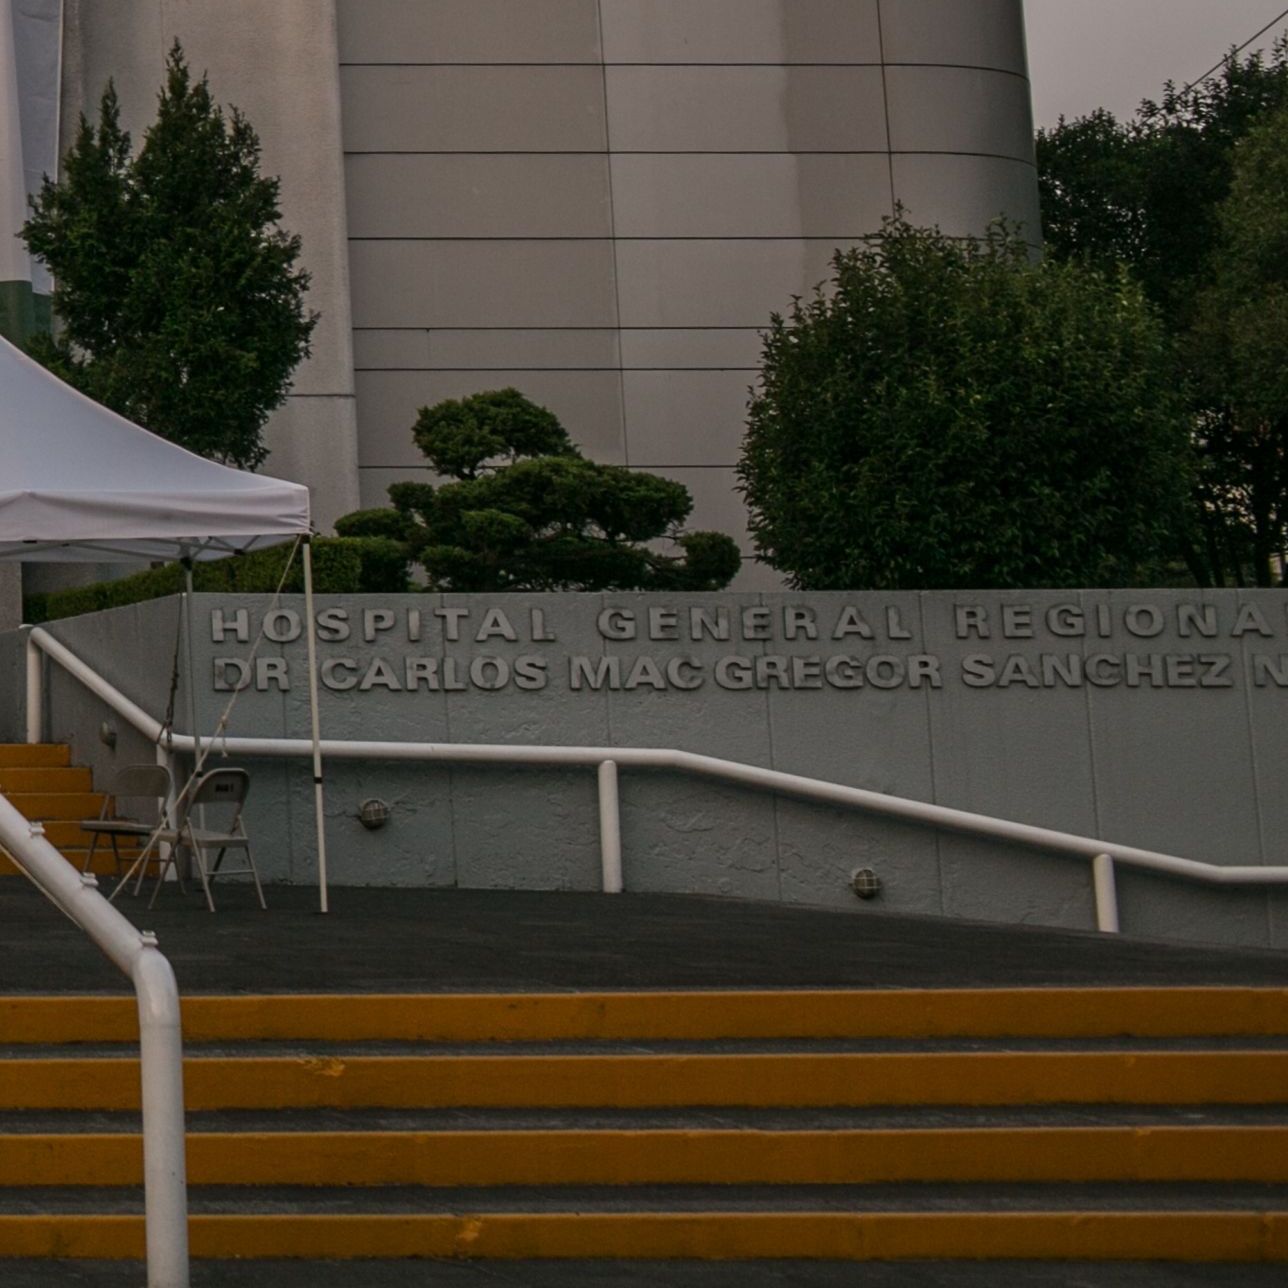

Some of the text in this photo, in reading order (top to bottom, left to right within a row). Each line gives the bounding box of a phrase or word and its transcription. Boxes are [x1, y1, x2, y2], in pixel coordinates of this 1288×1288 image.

[211, 602, 1288, 643] HOSPITAL GENERAL REGIONA
[212, 656, 290, 693] DR
[320, 655, 549, 692] CARLOS
[961, 653, 1234, 689] SANCHEZ
